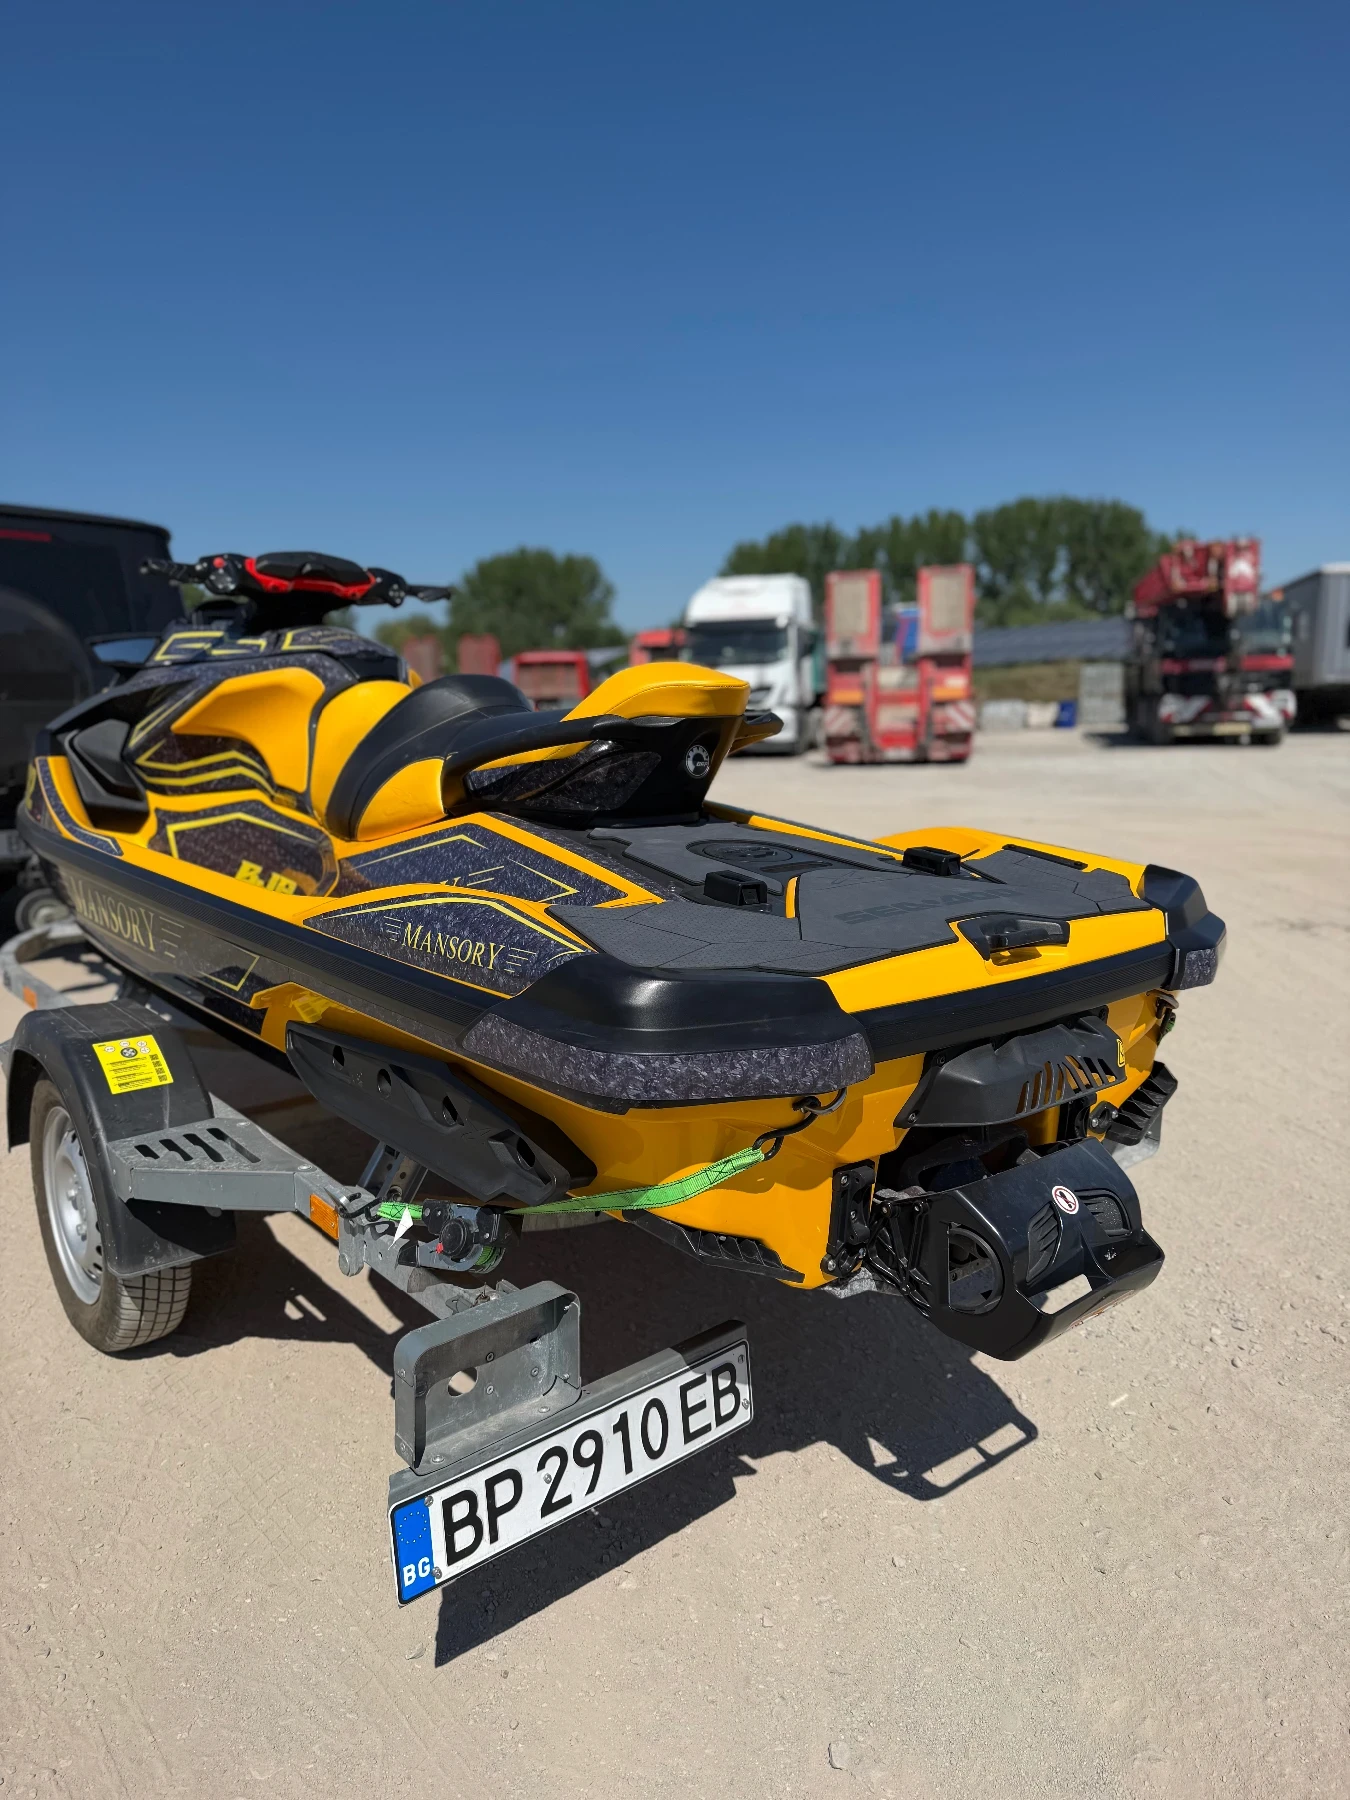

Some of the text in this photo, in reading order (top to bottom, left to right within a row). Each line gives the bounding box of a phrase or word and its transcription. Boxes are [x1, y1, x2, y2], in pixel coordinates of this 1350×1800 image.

[402, 922, 505, 970] MANSORY
[441, 1362, 741, 1567] BP 2910 EB
[402, 1556, 432, 1587] BG
